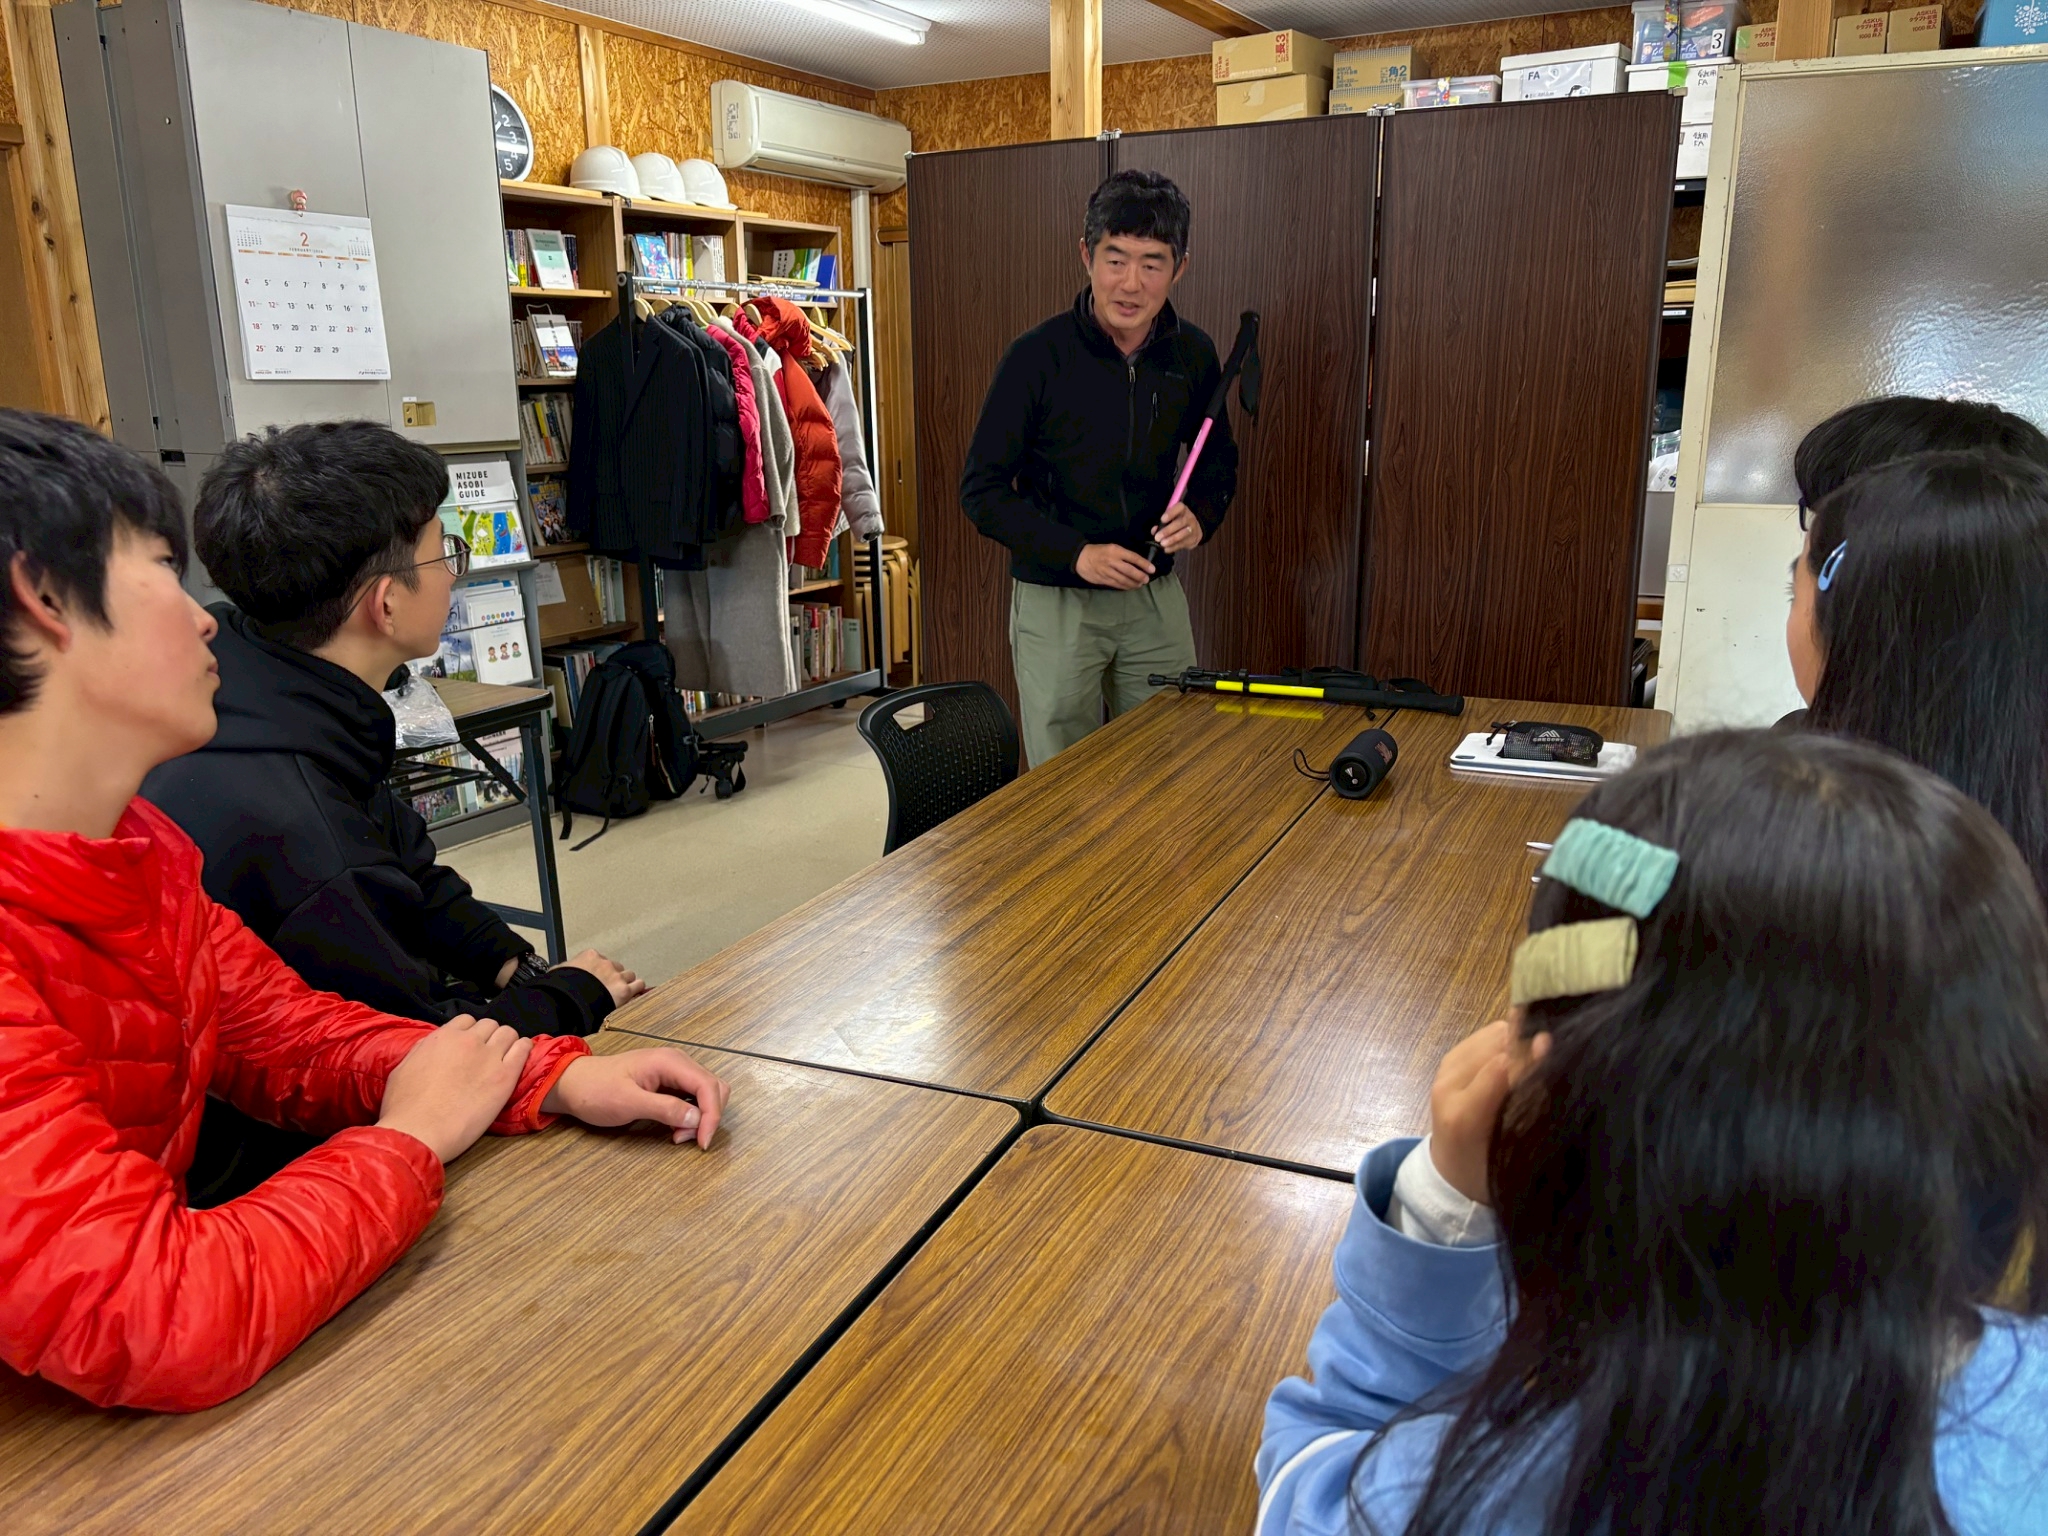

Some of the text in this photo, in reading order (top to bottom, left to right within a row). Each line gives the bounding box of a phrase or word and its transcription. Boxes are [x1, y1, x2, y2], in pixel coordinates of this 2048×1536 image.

[1712, 33, 1722, 49] 3
[1389, 65, 1407, 77] 角2
[1528, 71, 1540, 80] FA
[1698, 78, 1708, 86] FA
[502, 115, 511, 127] 2
[509, 132, 517, 144] 3
[504, 159, 513, 171] 5
[300, 232, 309, 247] 2
[456, 471, 488, 480] MIZUBE
[458, 480, 484, 489] ASOBI
[459, 489, 485, 498] GUIDE
